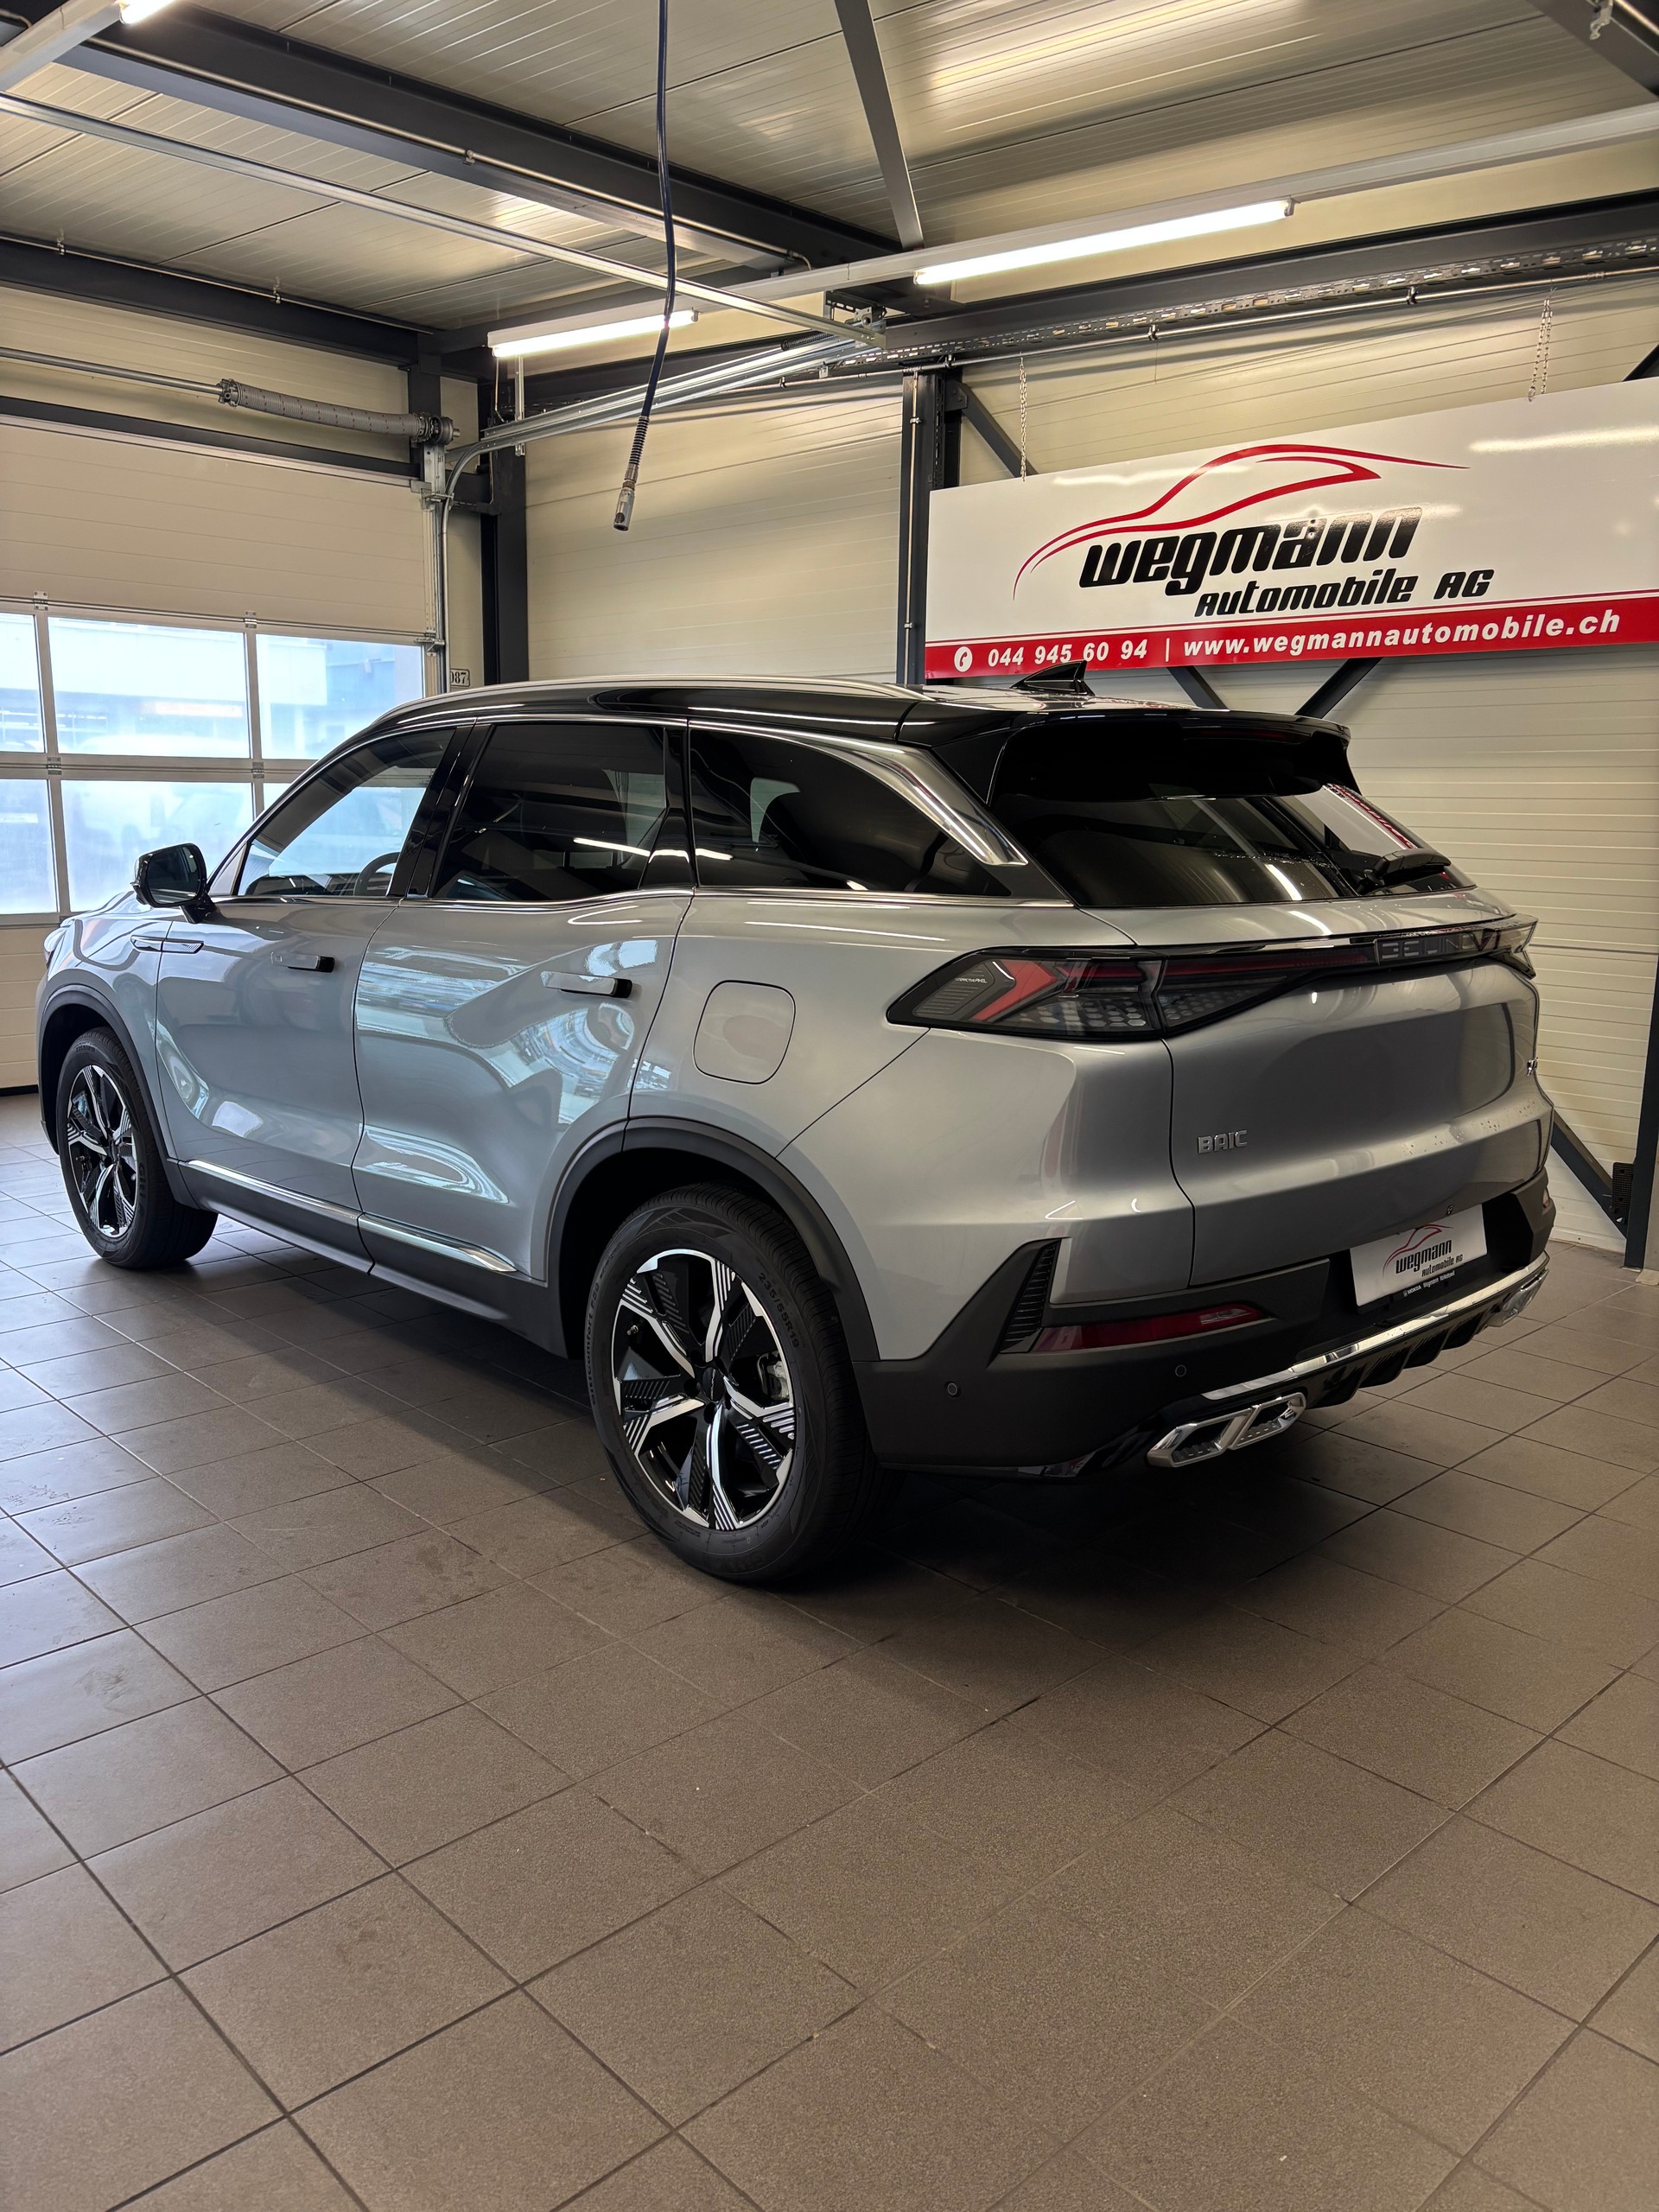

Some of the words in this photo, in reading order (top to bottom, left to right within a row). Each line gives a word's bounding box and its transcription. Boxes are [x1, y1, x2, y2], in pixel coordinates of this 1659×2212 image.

[1079, 506, 1423, 596] wegmann
[1433, 569, 1495, 600] AG
[988, 646, 1025, 667] 044
[1034, 644, 1072, 664] 945
[1083, 641, 1109, 662] 60
[1121, 639, 1148, 659] 94
[1184, 609, 1621, 657] www.wegmannautomobile.ch
[1198, 1129, 1248, 1154] BAIC
[1395, 1239, 1452, 1274] wegmann
[758, 1272, 799, 1348] 235/55R19
